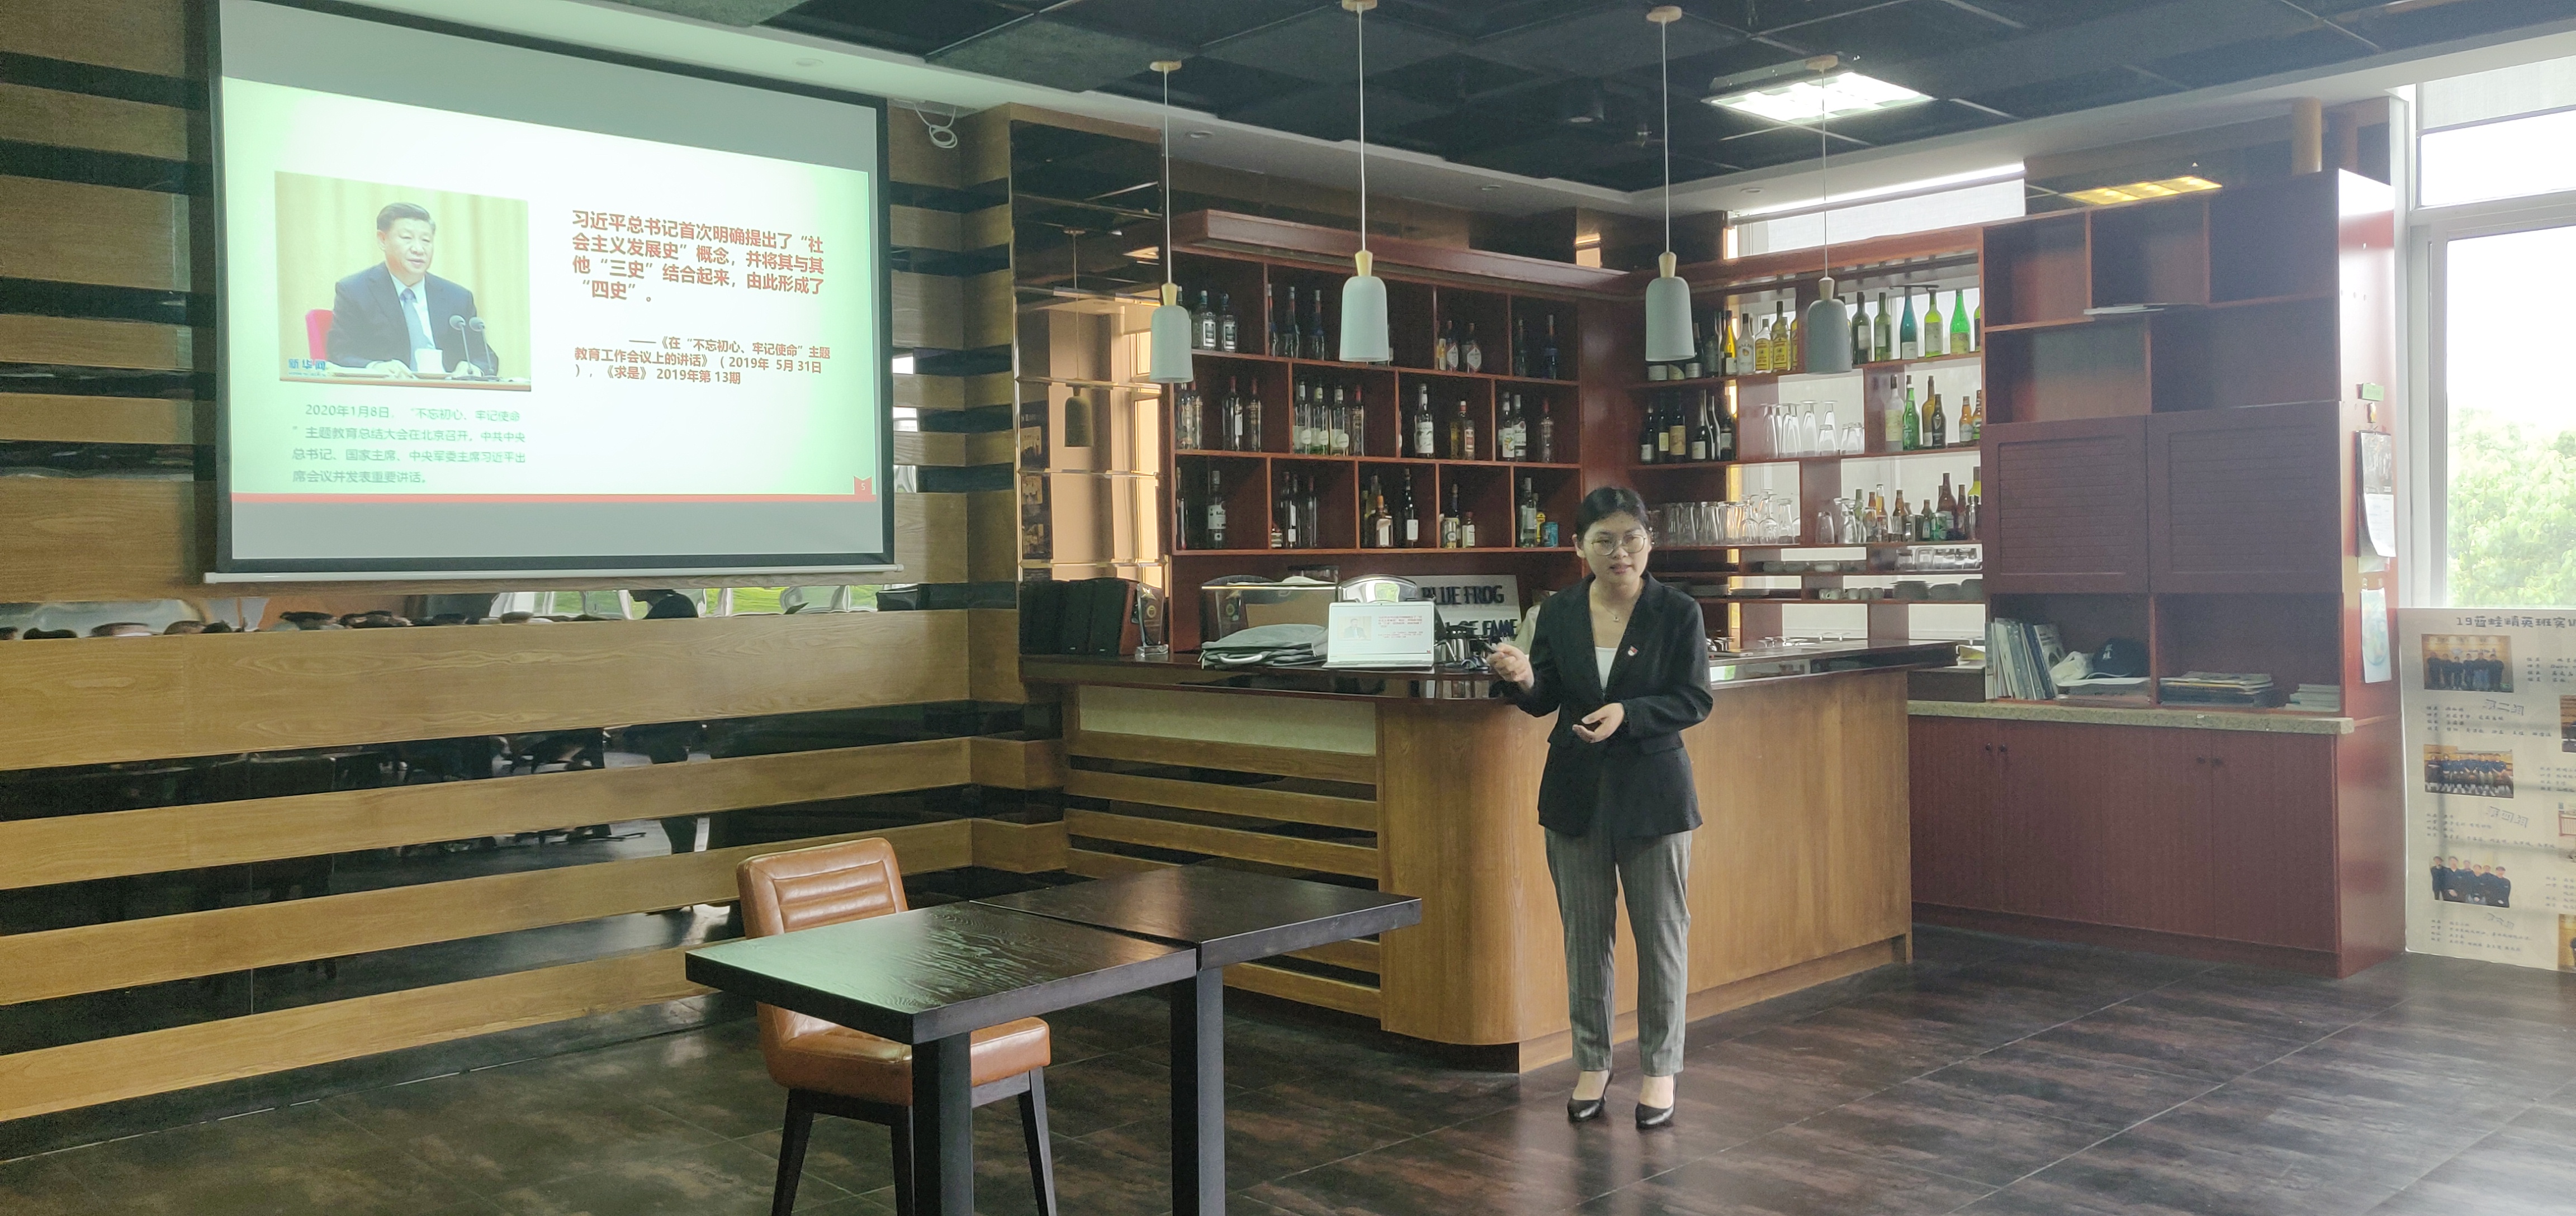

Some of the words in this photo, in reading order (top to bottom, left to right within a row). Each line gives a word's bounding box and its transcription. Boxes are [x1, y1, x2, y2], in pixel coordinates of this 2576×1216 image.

[1421, 587, 1462, 605] BLUE
[1464, 585, 1505, 604] FROG
[1483, 619, 1519, 638] FAME
